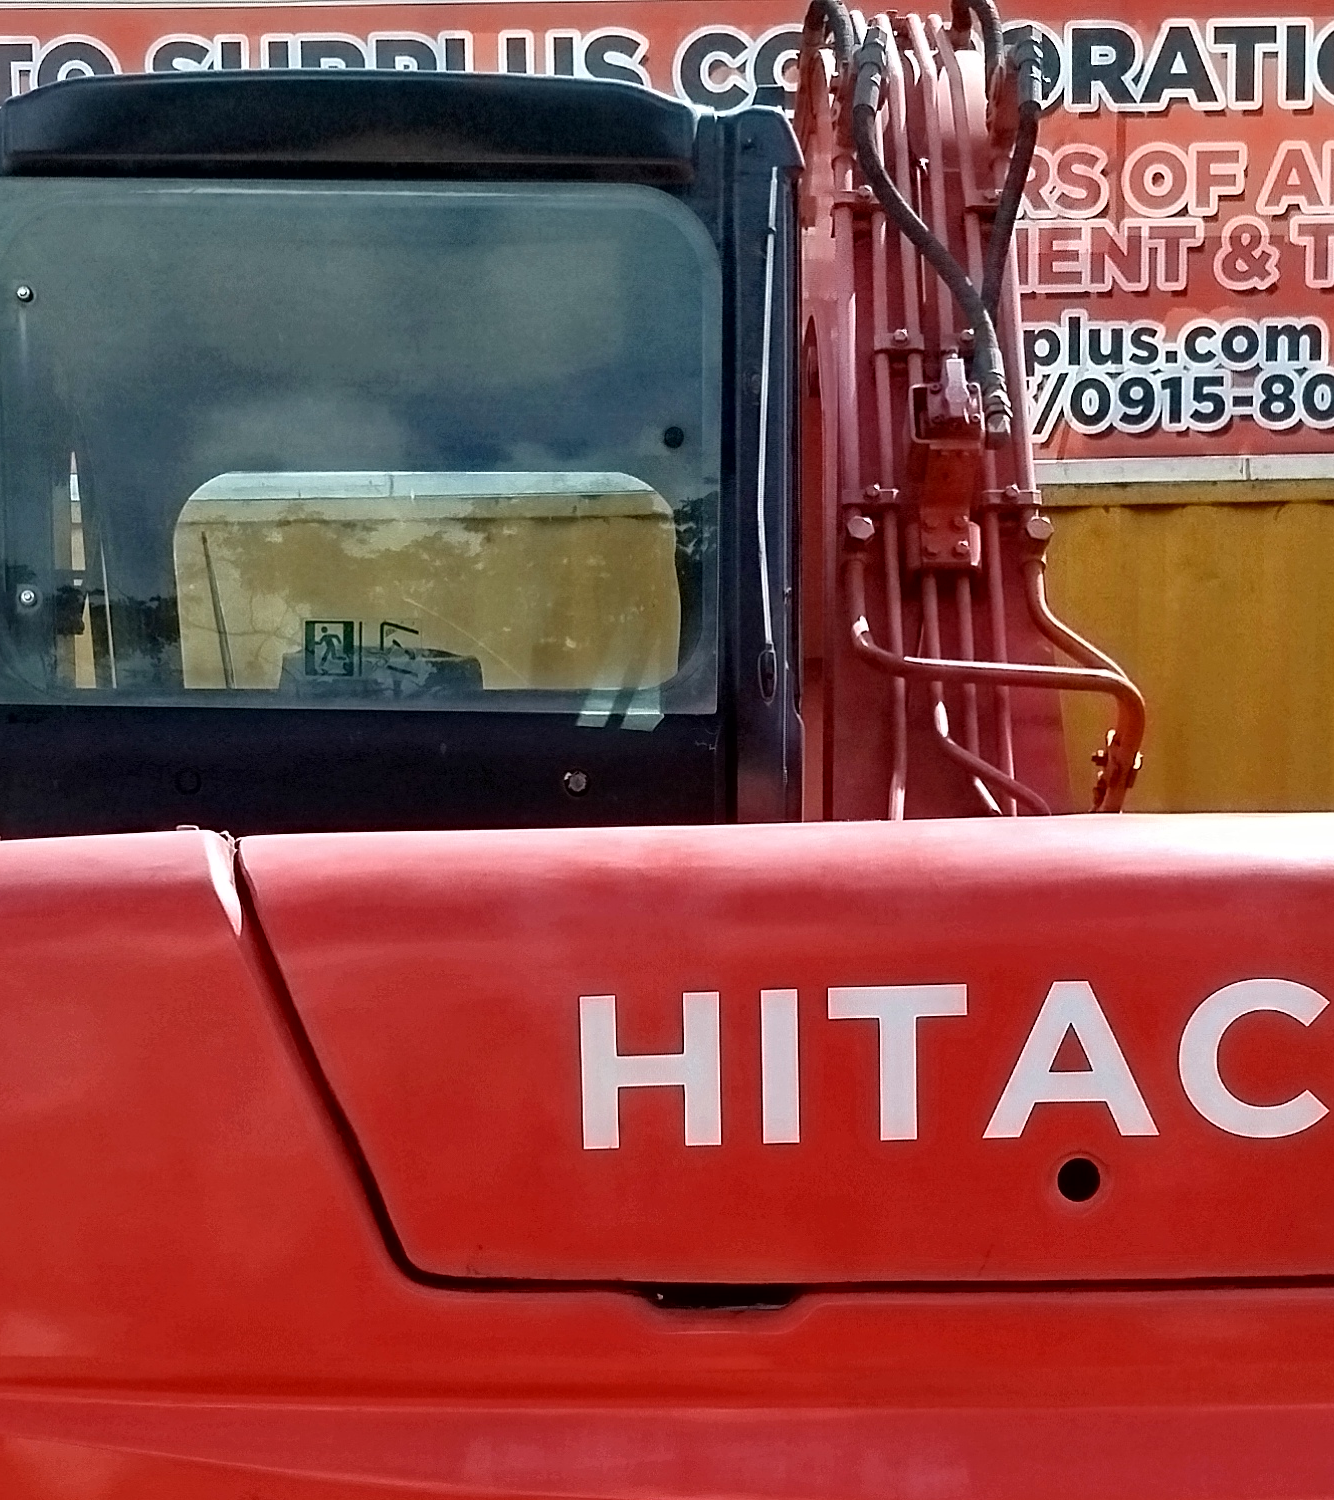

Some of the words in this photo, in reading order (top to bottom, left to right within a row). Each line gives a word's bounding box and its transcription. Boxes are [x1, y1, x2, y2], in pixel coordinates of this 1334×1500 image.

[1122, 141, 1248, 217] OF
[1018, 217, 1205, 292] ENT
[1214, 215, 1280, 291] &
